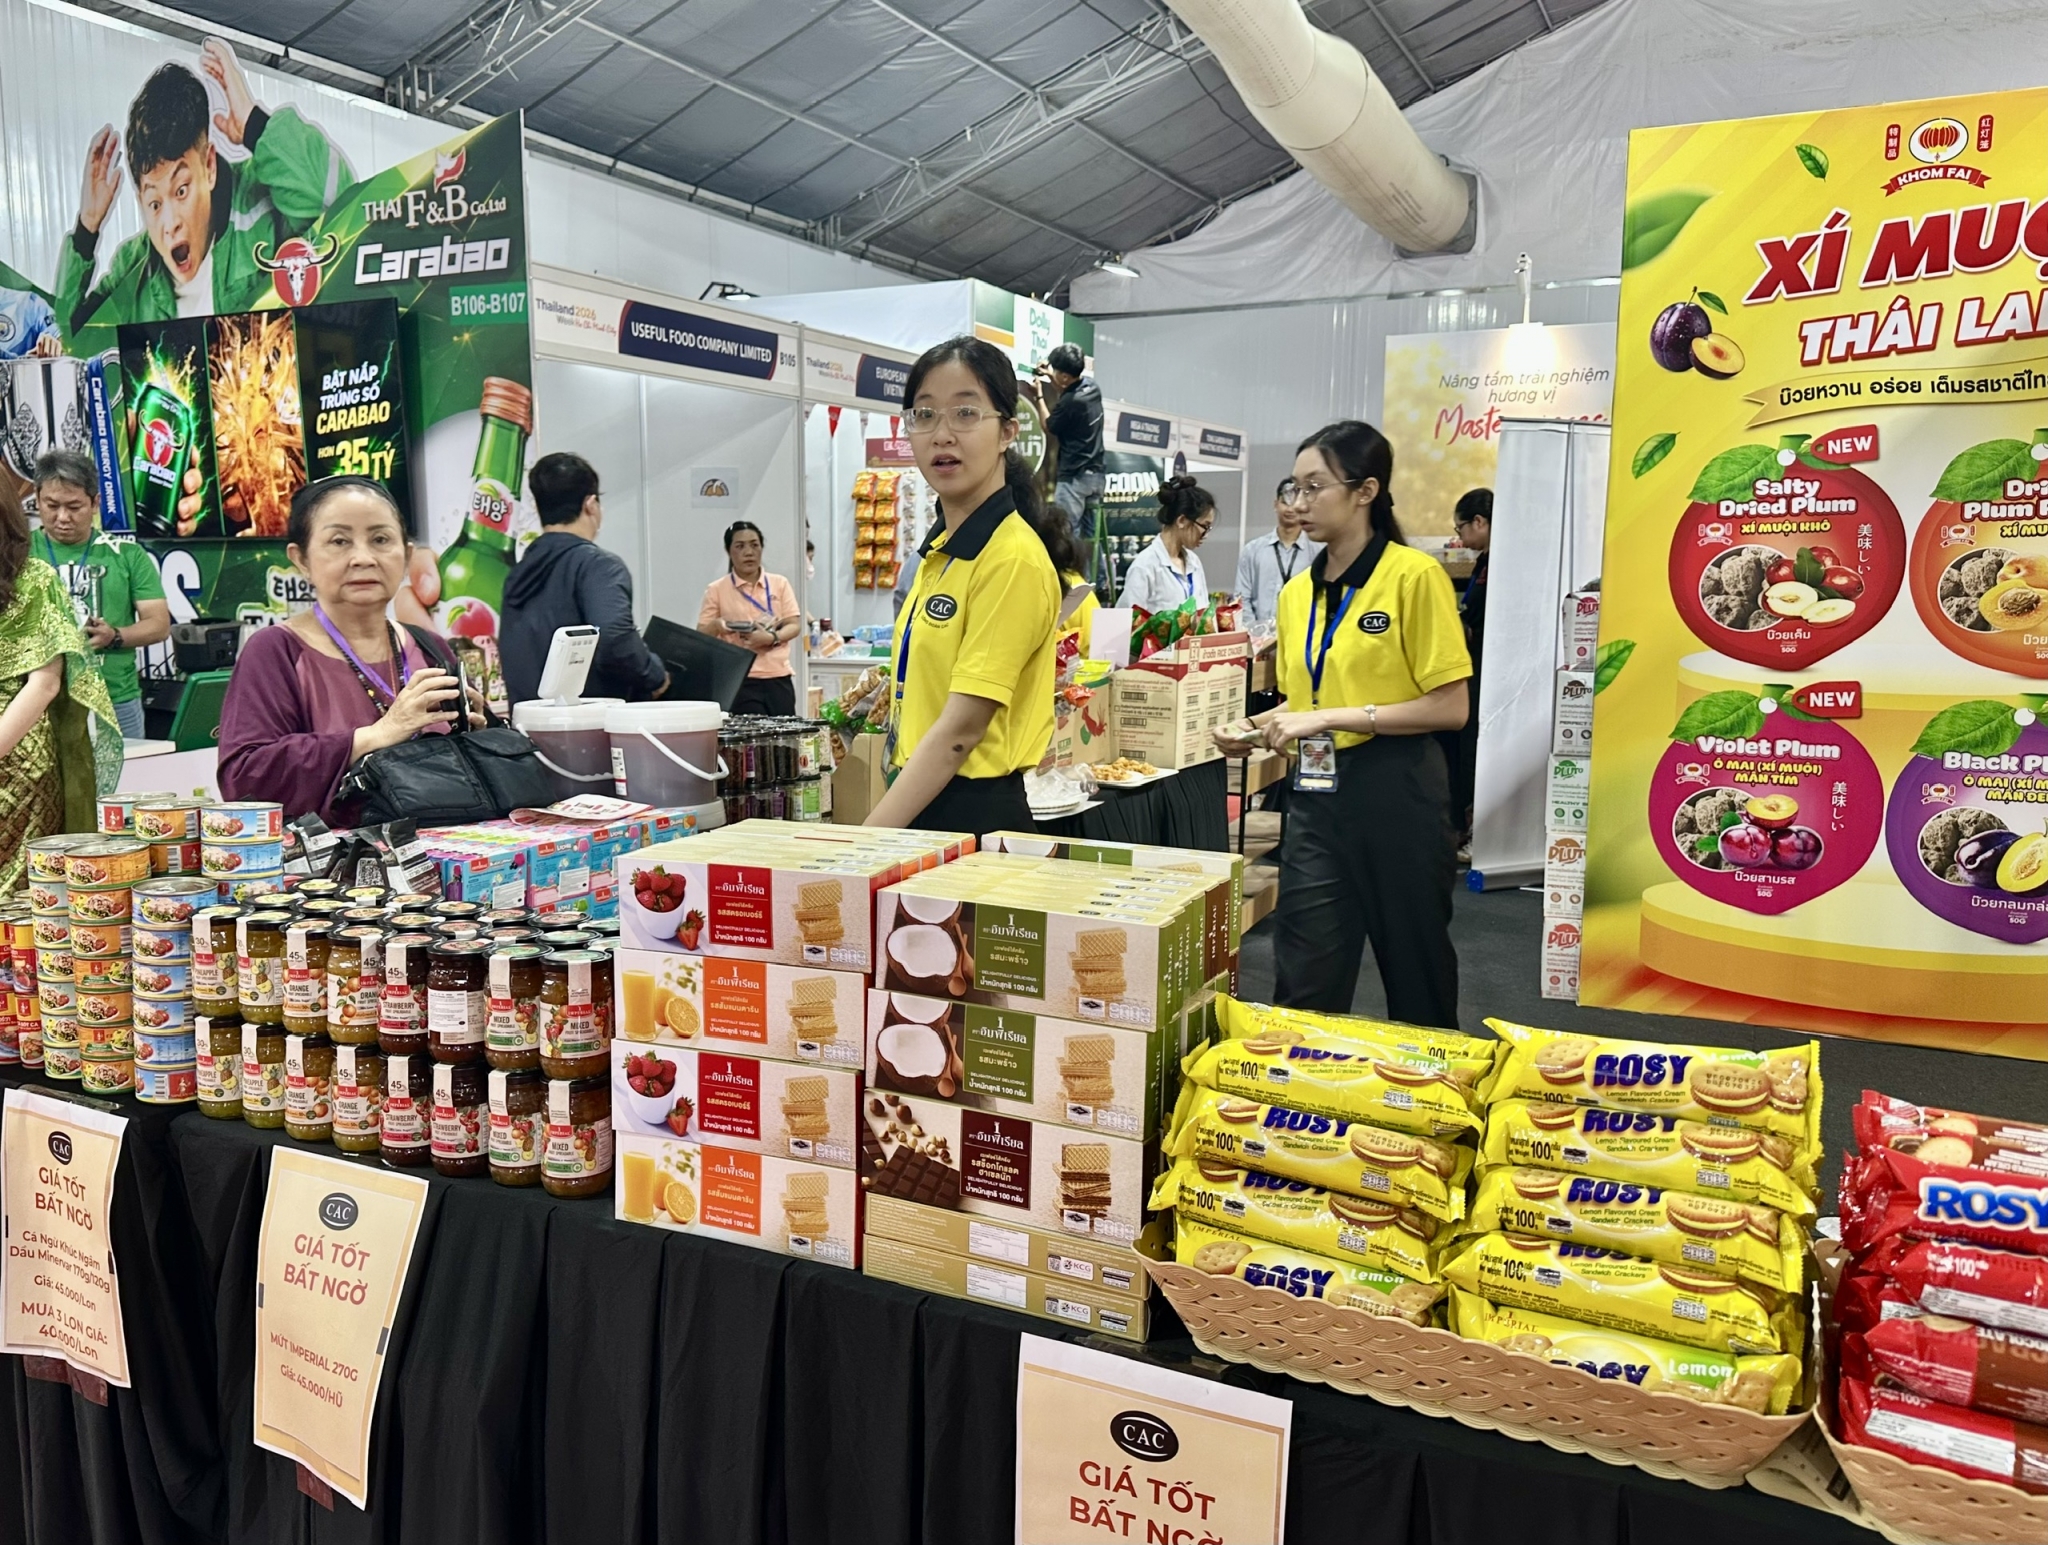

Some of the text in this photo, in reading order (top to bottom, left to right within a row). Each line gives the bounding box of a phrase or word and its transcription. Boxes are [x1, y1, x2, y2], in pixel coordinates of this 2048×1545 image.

[1897, 167, 1972, 185] KHOM FAI
[362, 200, 402, 222] THAI
[404, 184, 469, 227] F&B
[354, 235, 510, 285] Carabao
[1742, 208, 1852, 306] XÍ
[451, 293, 526, 316] B106-B107
[536, 298, 574, 315] Thailand
[631, 321, 773, 363] USEFUL FOOD COMPANY LIMITED
[1799, 295, 1943, 367] THÁI
[780, 351, 796, 367] B105
[322, 361, 379, 392] BẬT NẮP
[1439, 374, 1479, 389] Nâng
[1550, 367, 1610, 385] nghiệm
[1931, 369, 2048, 394] เต็มรสชาติไท
[320, 380, 380, 410] TRÚNG SỐ
[316, 401, 391, 435] CARABAO
[1434, 403, 1501, 445] Maste
[91, 377, 117, 514] Carabao ENERGY DRINK
[335, 437, 370, 475] 35
[1827, 435, 1873, 455] NEW
[1753, 477, 1821, 498] Salty
[471, 489, 510, 522] 태양
[1717, 497, 1857, 517] Dried Plum
[1962, 502, 2034, 521] Plum
[1857, 524, 1872, 575] 美味しい
[930, 600, 951, 614] CAC
[1362, 616, 1387, 629] CAC
[1809, 691, 1857, 708] NEW
[1696, 735, 1841, 759] Violet Plum
[1943, 751, 2019, 772] Black
[1713, 758, 1724, 769] Ô
[1726, 761, 1755, 771] MAI
[1963, 774, 1975, 787] Ô
[1977, 776, 2009, 789] MAI
[1831, 781, 1848, 832] 美味しい
[1593, 1054, 1693, 1087] ROSY
[52, 1138, 71, 1157] CAC
[38, 1166, 86, 1201] GIÁ TỐT
[34, 1191, 93, 1231] BẤT NGỜ
[325, 1203, 352, 1221] CAC
[9, 1245, 35, 1259] Dầu
[22, 1230, 38, 1242] Cá
[39, 1232, 59, 1249] Ngừ
[293, 1233, 371, 1272] GIÁ TỐT
[1073, 1263, 1091, 1272] KCG
[1350, 1267, 1405, 1284] Lemon
[34, 1274, 97, 1313] Giá: 45.000/Lon
[283, 1262, 369, 1306] BẤT NGỜ
[21, 1301, 108, 1346] MUA 3 LON GIÁ:
[38, 1323, 99, 1361] 40.000/Lon
[269, 1331, 359, 1383] MỨT IMPERIAL 270G
[280, 1363, 344, 1408] Giá: 45.000/HŨ
[1123, 1424, 1165, 1449] CAC
[1079, 1460, 1216, 1520] GIÁ TỐT
[1069, 1496, 1137, 1537] BẤT
